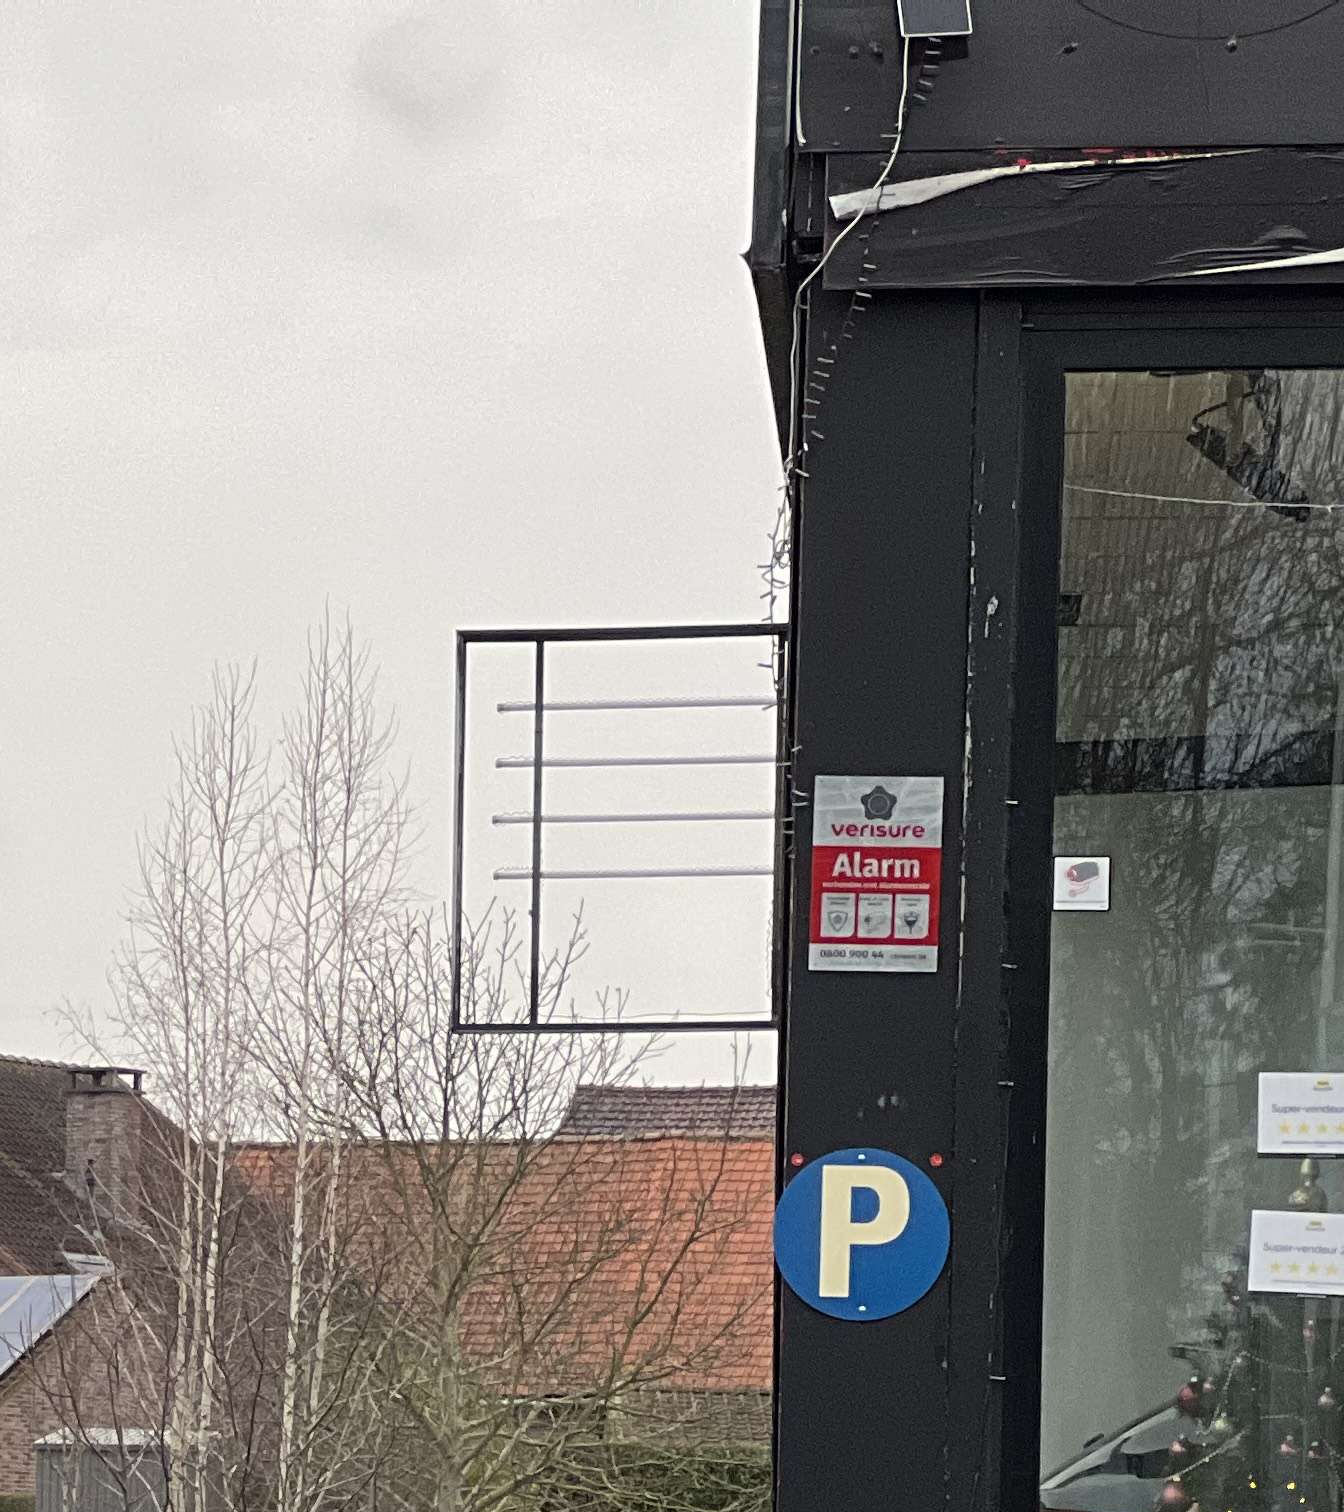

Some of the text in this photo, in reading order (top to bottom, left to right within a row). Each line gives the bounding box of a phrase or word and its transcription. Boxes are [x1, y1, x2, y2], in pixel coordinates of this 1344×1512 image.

[831, 823, 926, 838] verisure
[832, 851, 921, 879] Alarm
[819, 1164, 910, 1298] P
